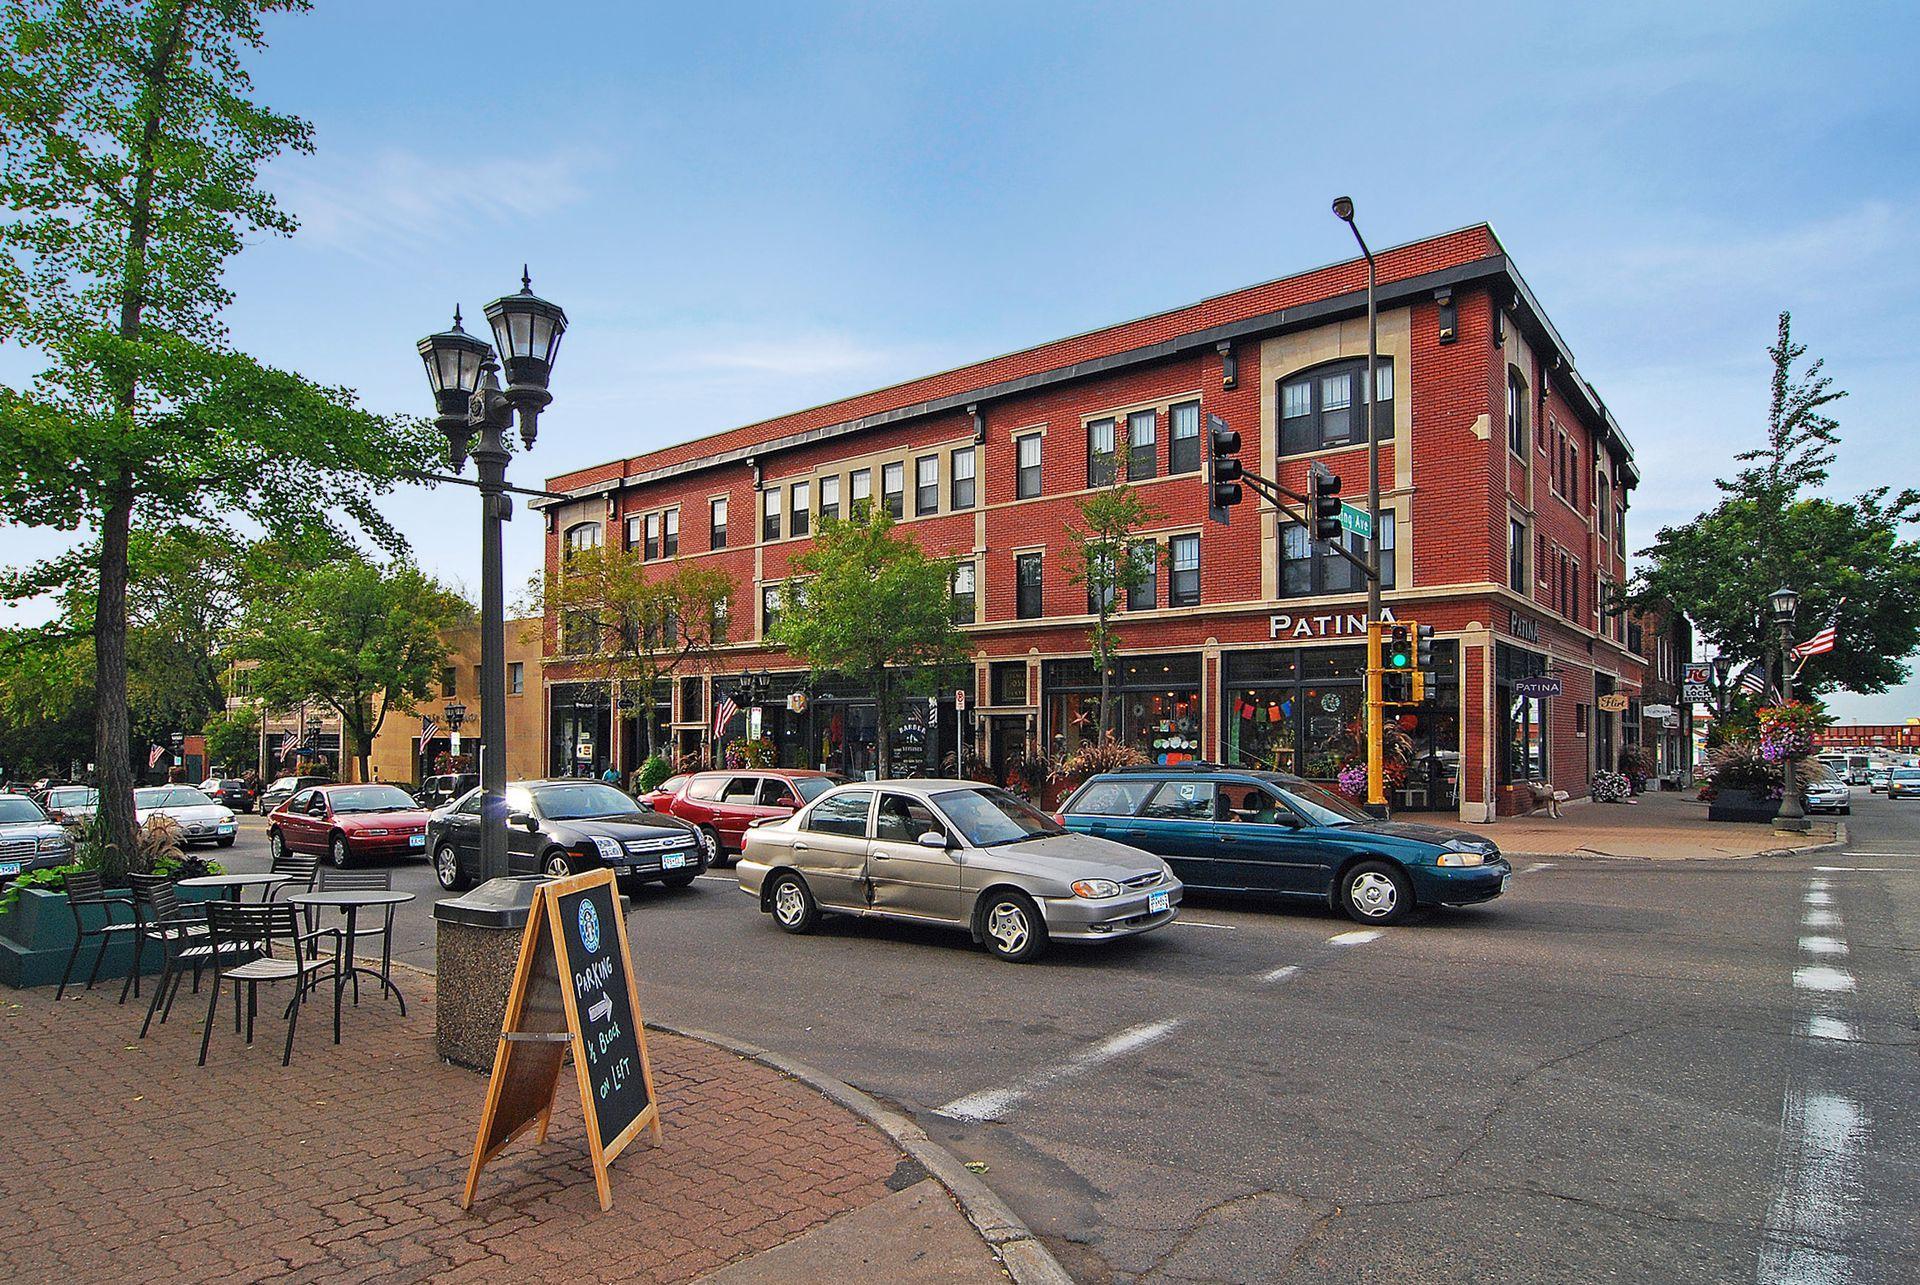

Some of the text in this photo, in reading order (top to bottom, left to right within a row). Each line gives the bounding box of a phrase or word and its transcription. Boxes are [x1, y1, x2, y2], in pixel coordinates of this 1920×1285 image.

[1355, 515, 1369, 531] Ave
[1269, 607, 1398, 638] PATINA
[1511, 610, 1539, 644] PATINA
[1687, 668, 1710, 682] RC
[1516, 683, 1560, 692] PATINA
[1600, 696, 1626, 708] Flirt
[575, 956, 613, 999] PARKING
[611, 1056, 631, 1091] LEFT
